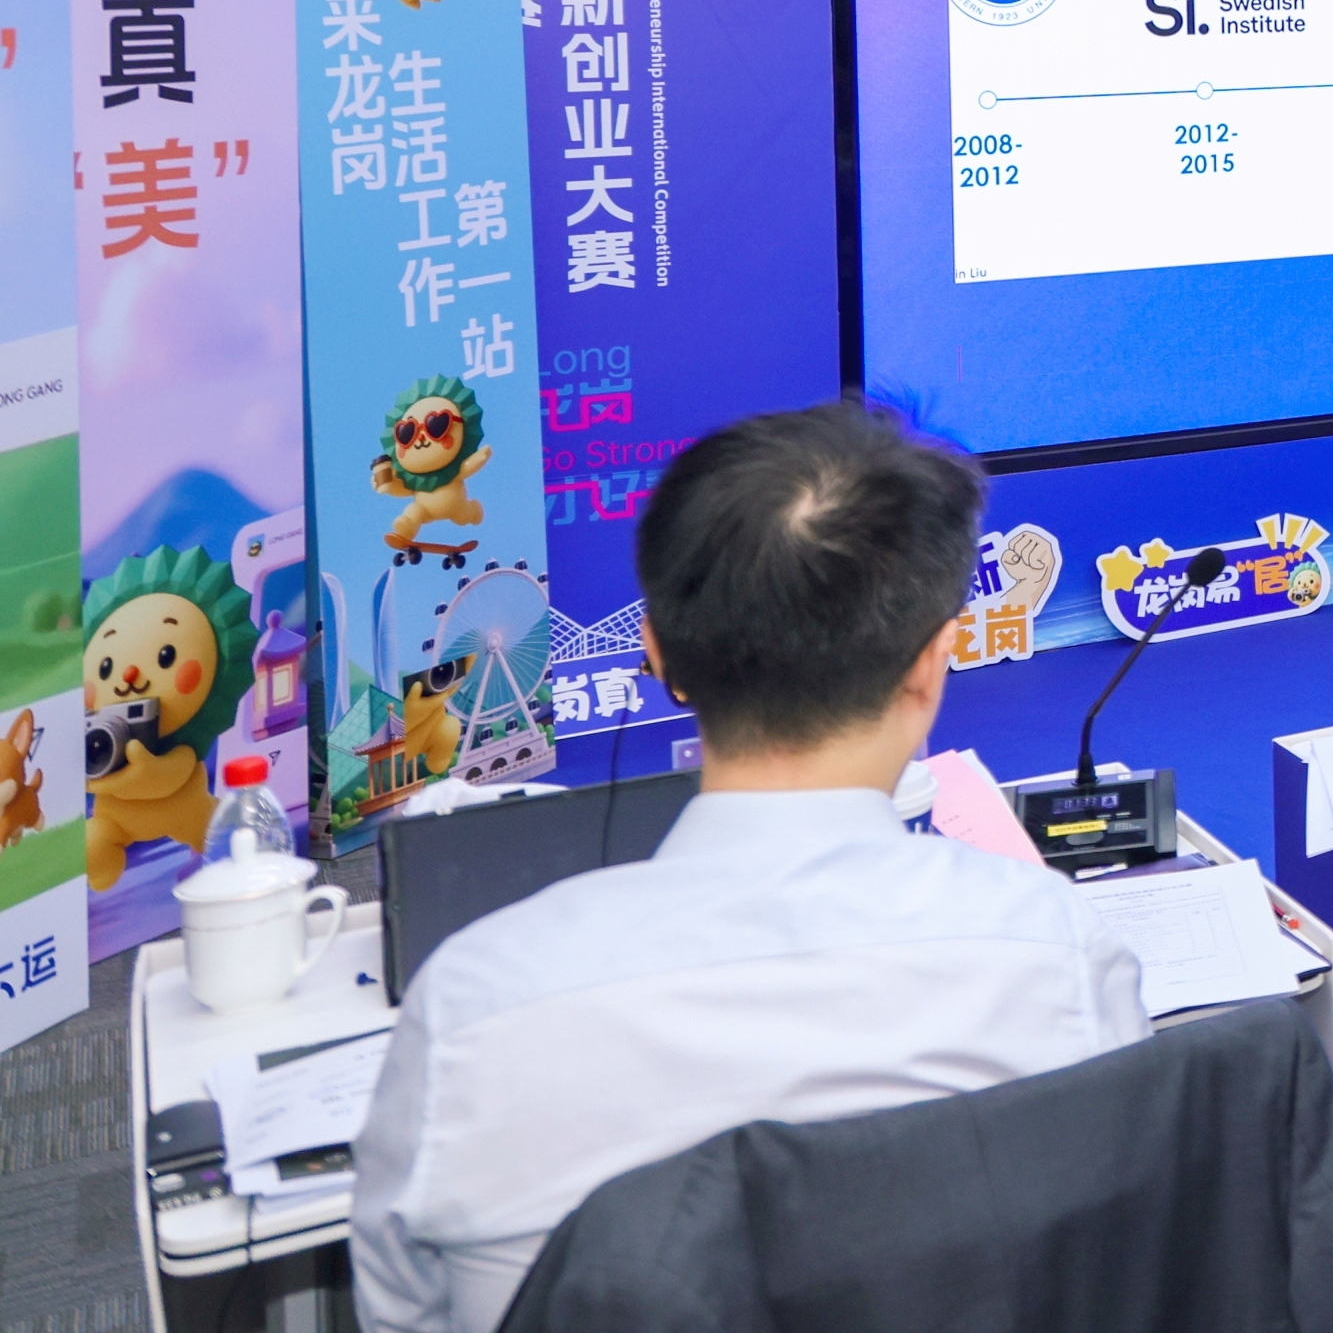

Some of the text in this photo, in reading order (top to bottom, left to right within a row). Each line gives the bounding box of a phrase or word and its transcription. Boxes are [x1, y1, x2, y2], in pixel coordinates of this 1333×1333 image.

[1220, 15, 1306, 35] Institute
[650, 81, 669, 187] International
[953, 134, 1023, 157] 2008-
[1174, 123, 1239, 145] 2012-
[1180, 152, 1235, 175] 2015
[959, 164, 1020, 188] 2012
[387, 49, 457, 329] 生活工作
[650, 188, 672, 288] Competition
[453, 179, 515, 382] 第一站
